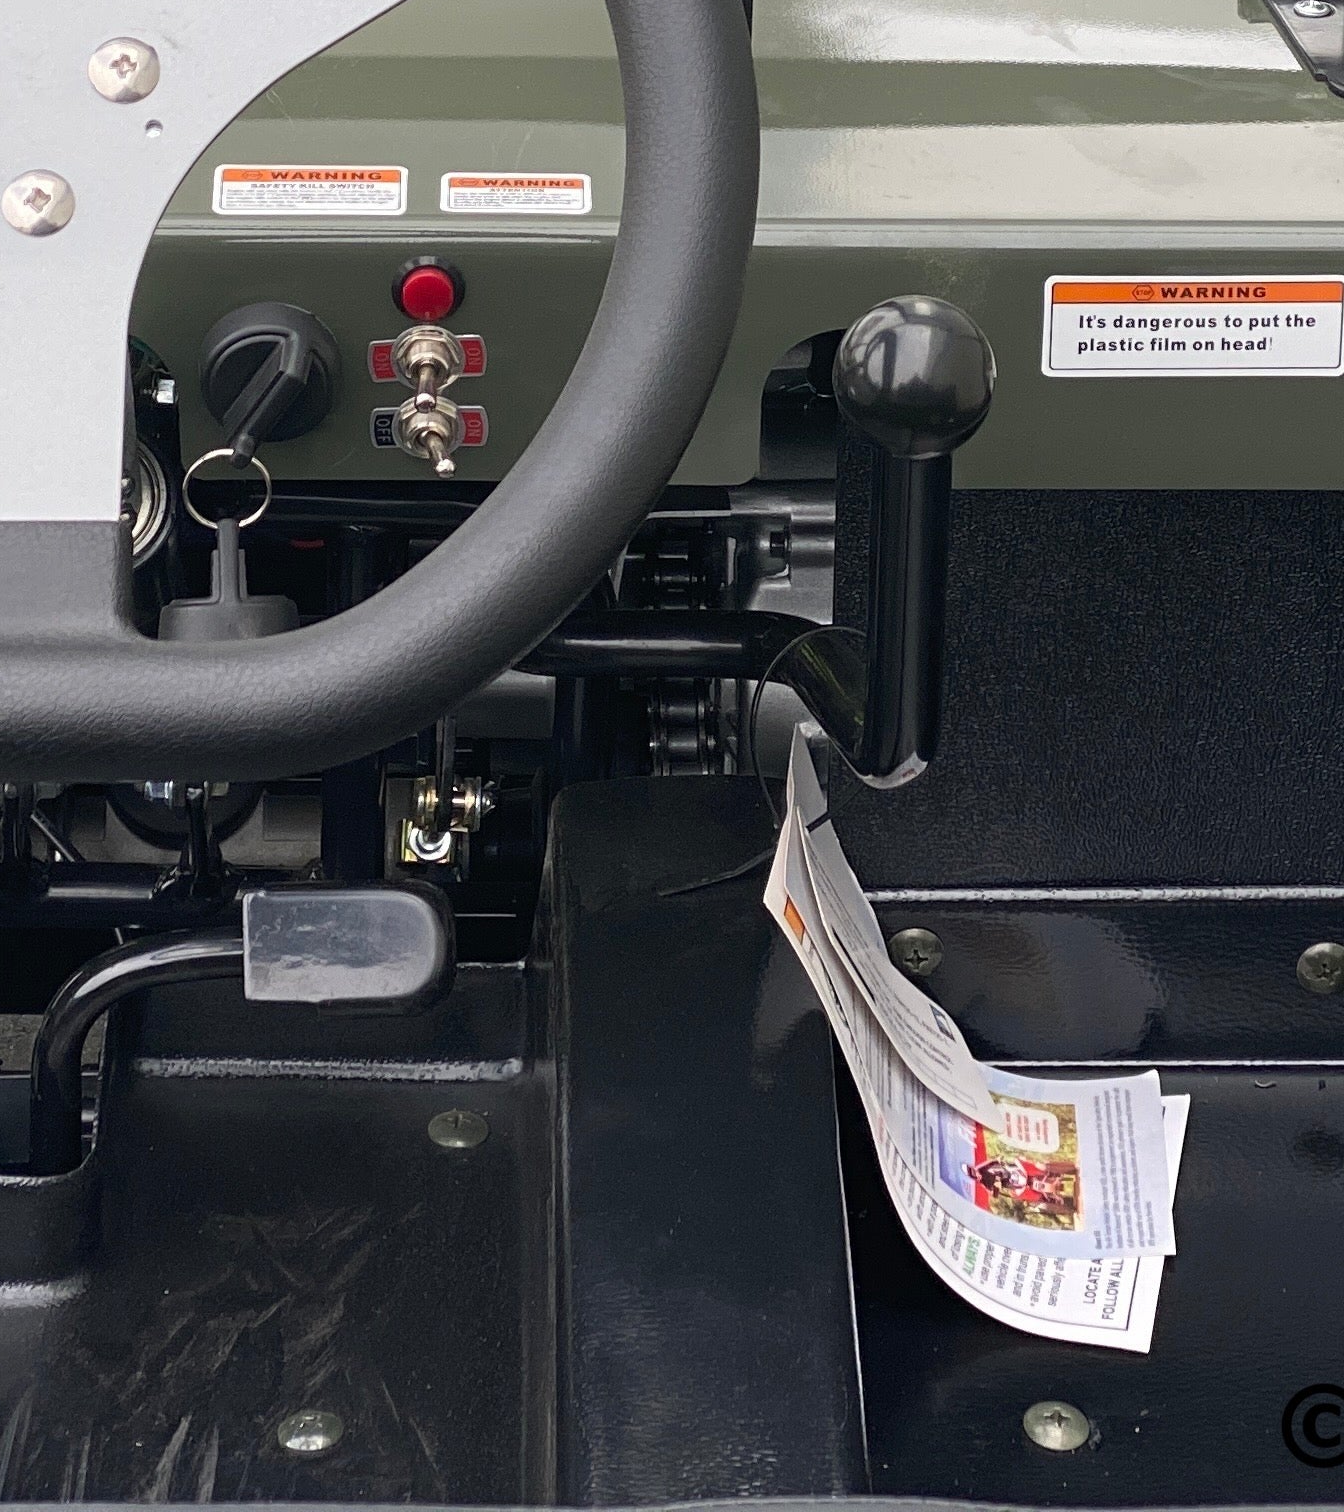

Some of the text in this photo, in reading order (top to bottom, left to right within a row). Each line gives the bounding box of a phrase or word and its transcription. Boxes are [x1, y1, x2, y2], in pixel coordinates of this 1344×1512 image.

[271, 171, 382, 180] WARNING
[483, 179, 575, 187] WARNING
[1161, 286, 1267, 298] WARNING
[1079, 314, 1317, 331] It's dangerous to put the
[1077, 338, 1145, 354] plastic
[1150, 338, 1186, 351] film
[1192, 340, 1215, 351] on
[376, 353, 391, 378] ON
[467, 348, 481, 366] ON
[376, 418, 392, 444] OFF
[467, 419, 481, 438] ON
[1083, 1266, 1103, 1304] LOCATE
[1102, 1259, 1125, 1320] FOLLOW ALL
